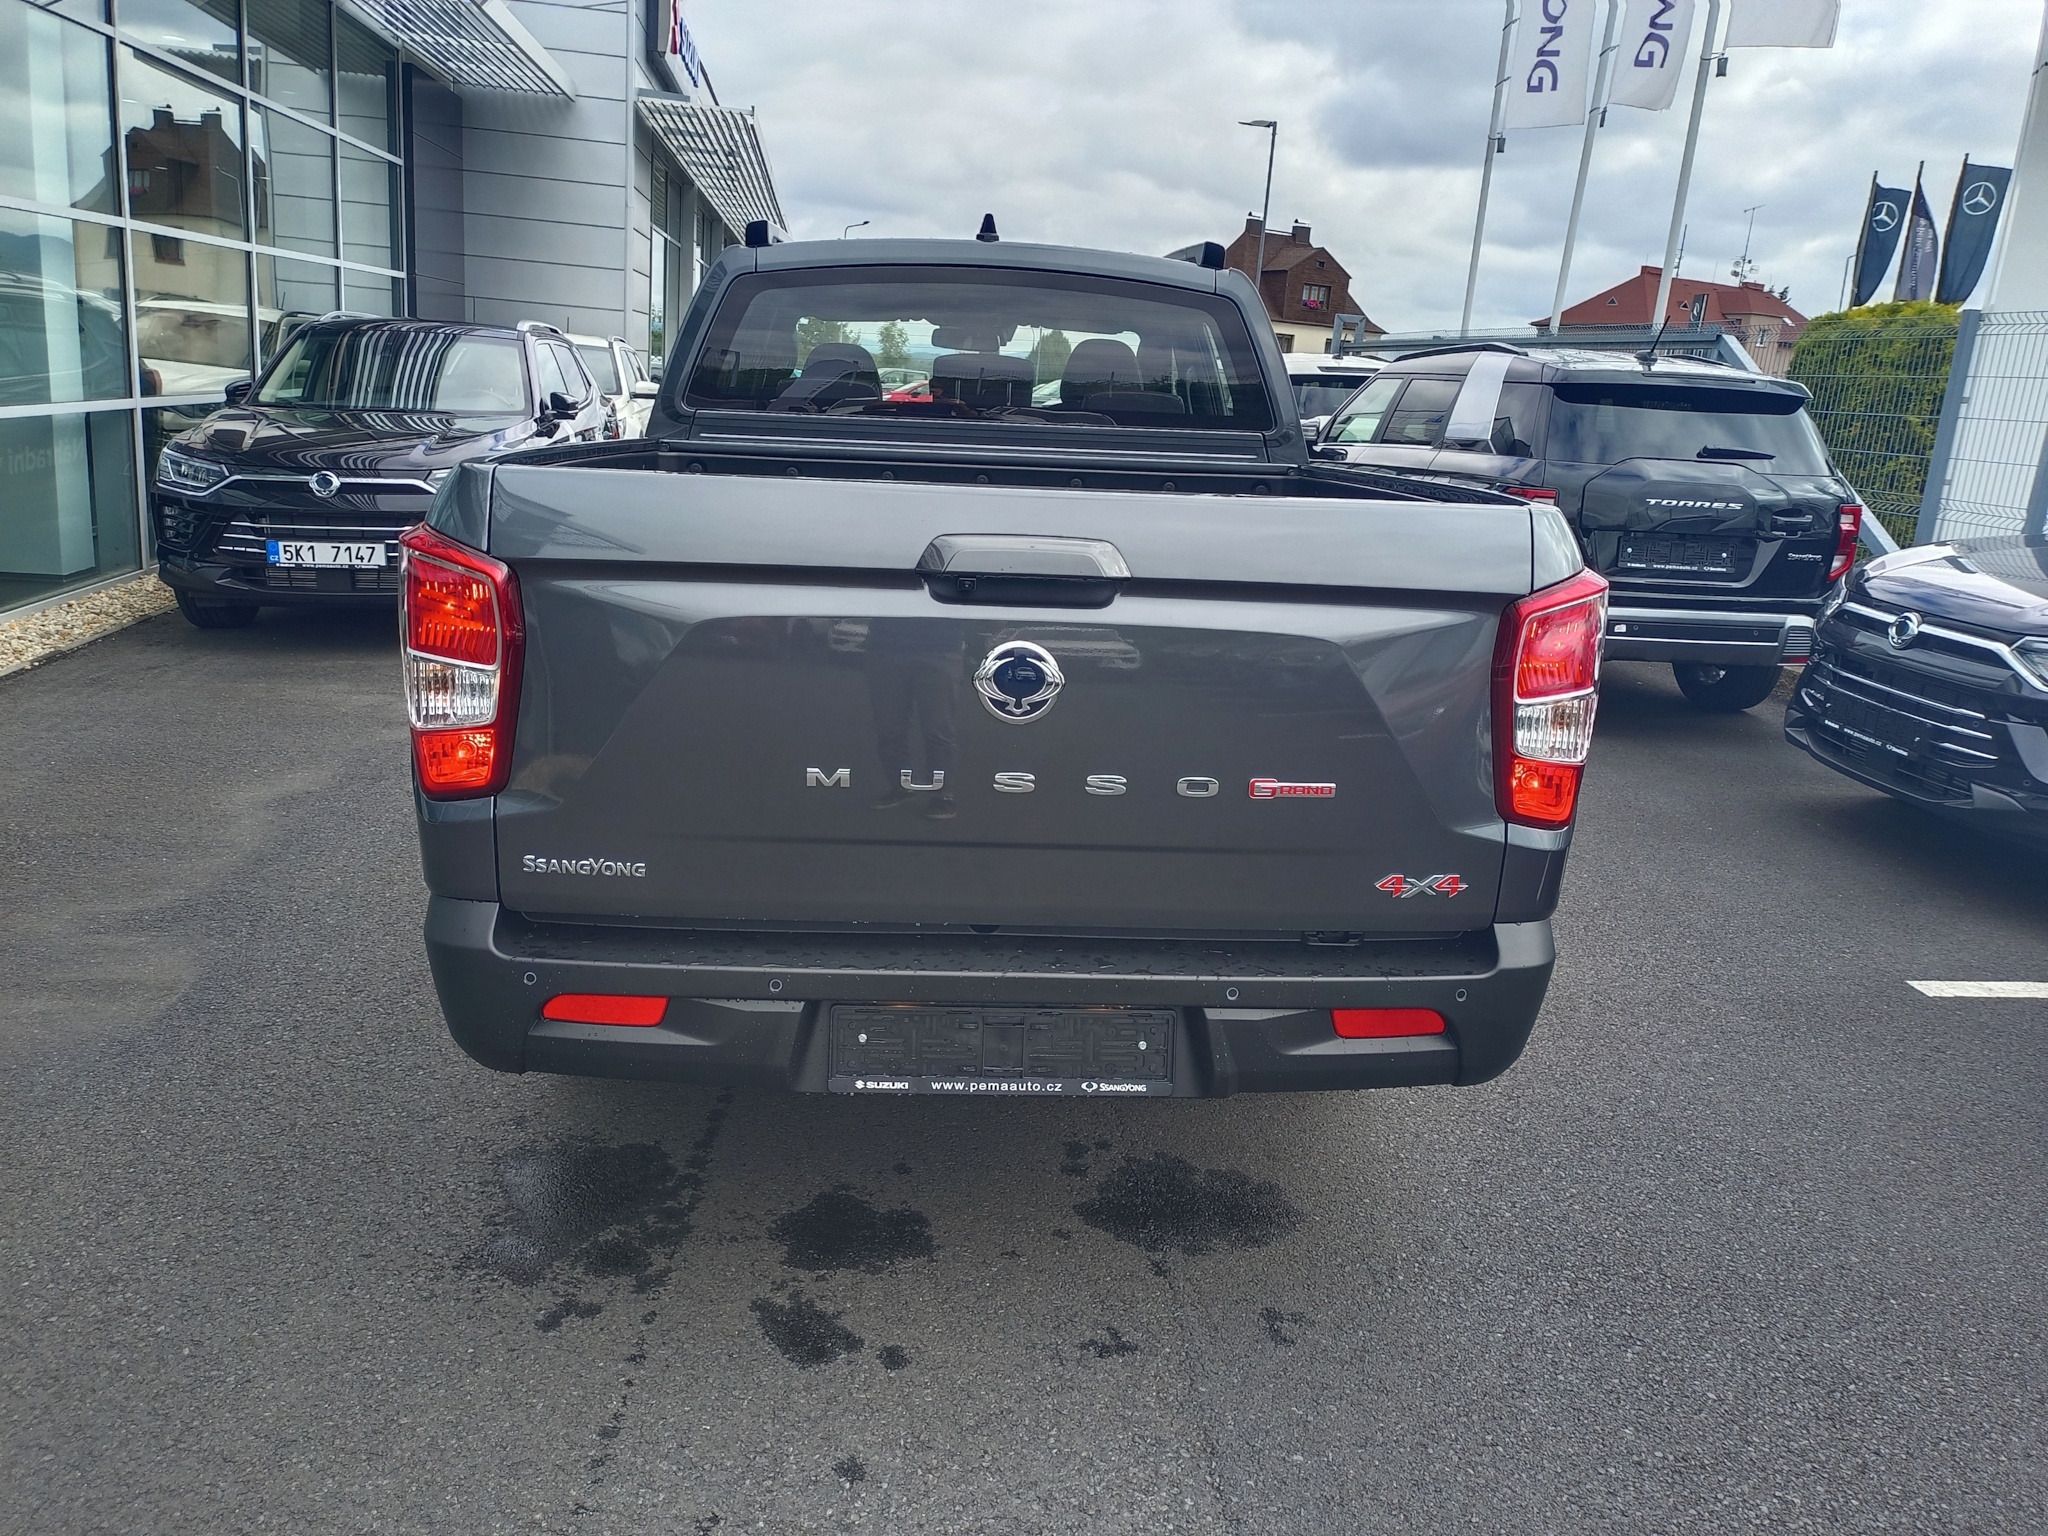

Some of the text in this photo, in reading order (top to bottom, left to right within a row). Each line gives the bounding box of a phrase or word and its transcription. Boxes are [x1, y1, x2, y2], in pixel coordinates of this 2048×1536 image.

[1646, 498, 1744, 510] TORRES
[283, 544, 376, 563] 5K1 7147
[806, 767, 1336, 799] MUSSO GRAND
[522, 854, 647, 878] SSANGYONG
[865, 1080, 1147, 1093] SUZUKI www.pemaauto.cz SSANGYONG
